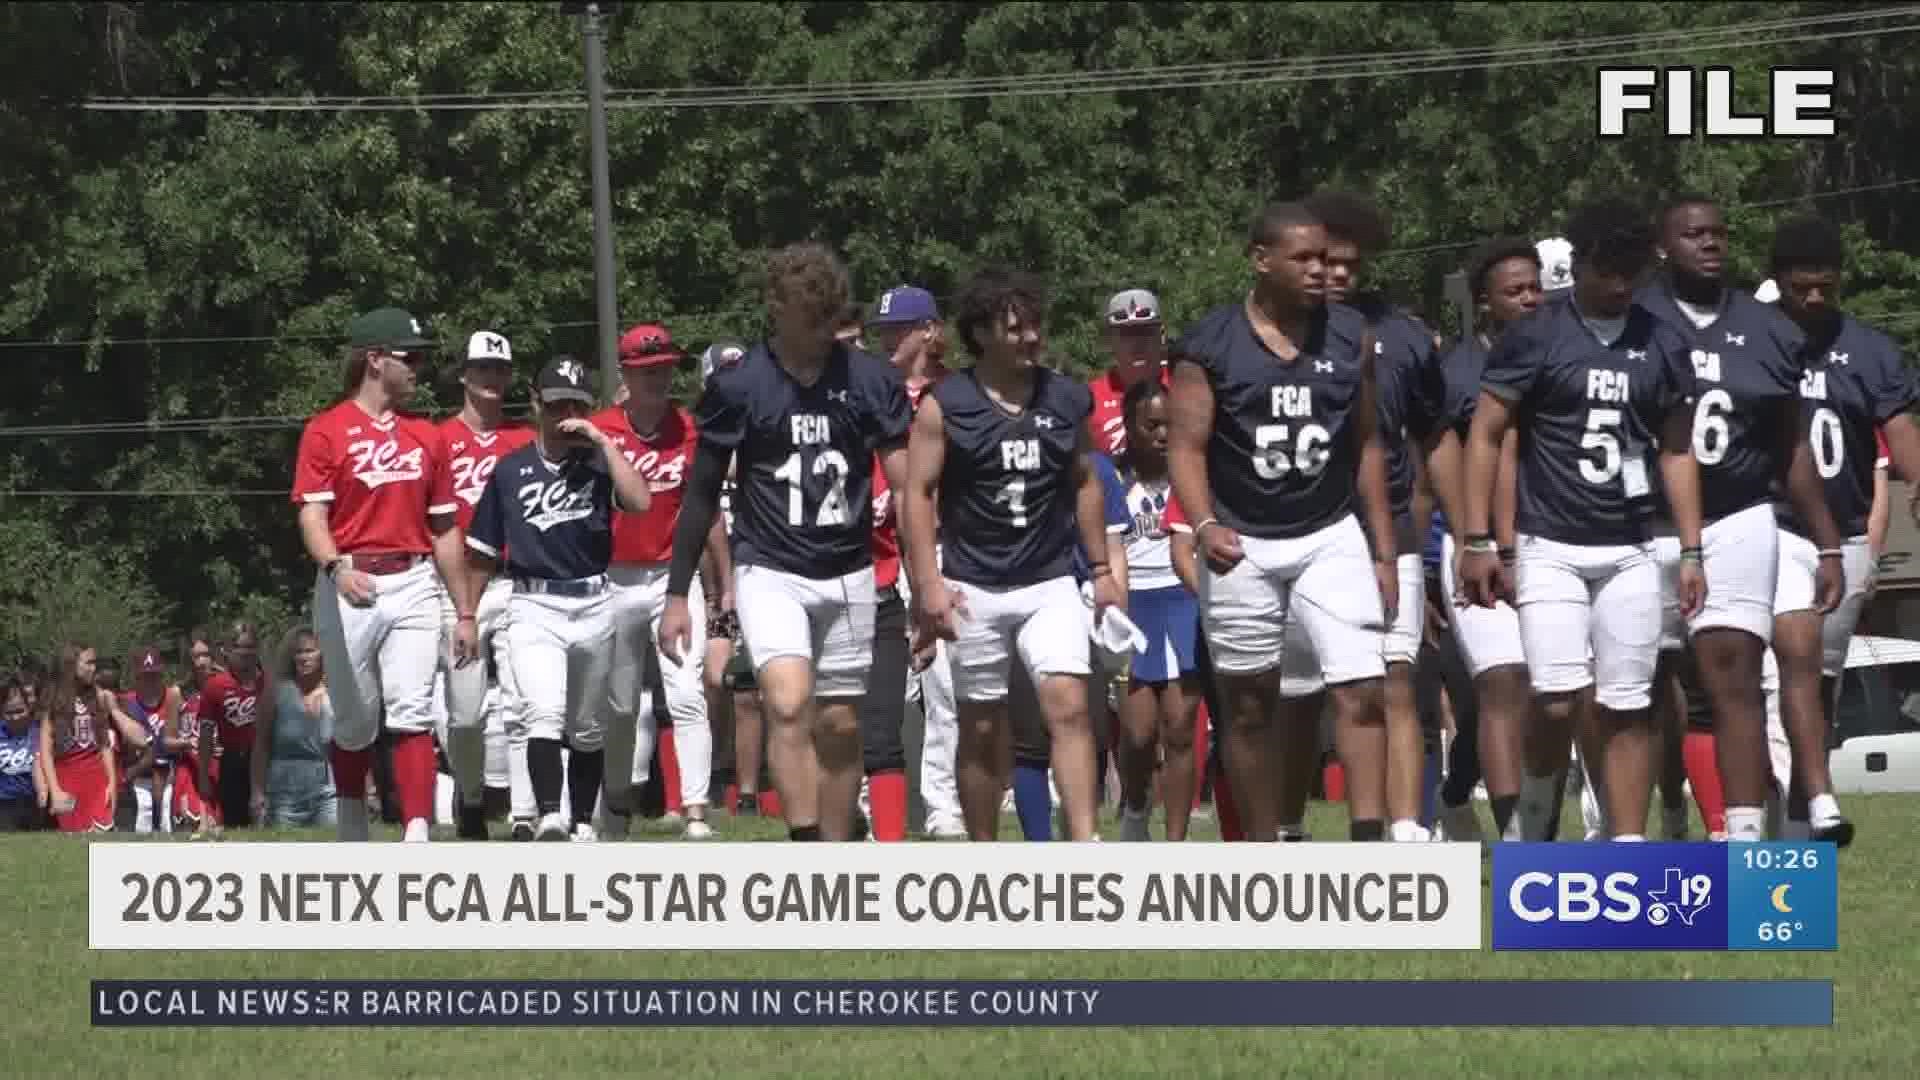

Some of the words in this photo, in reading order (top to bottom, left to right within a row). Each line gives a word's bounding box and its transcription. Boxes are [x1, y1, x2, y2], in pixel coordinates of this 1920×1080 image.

[1691, 350, 1721, 382] CA
[1271, 385, 1312, 417] FCA
[1587, 368, 1629, 402] FCA
[1800, 368, 1827, 400] CA
[791, 415, 832, 445] FCA
[1685, 389, 1734, 466] 6
[1810, 407, 1844, 479] 0
[347, 440, 424, 477] FCA
[1001, 439, 1041, 471] FCA
[1252, 424, 1331, 480] 56
[1578, 408, 1622, 484] 5
[450, 456, 498, 490] FC
[774, 450, 849, 526] 12
